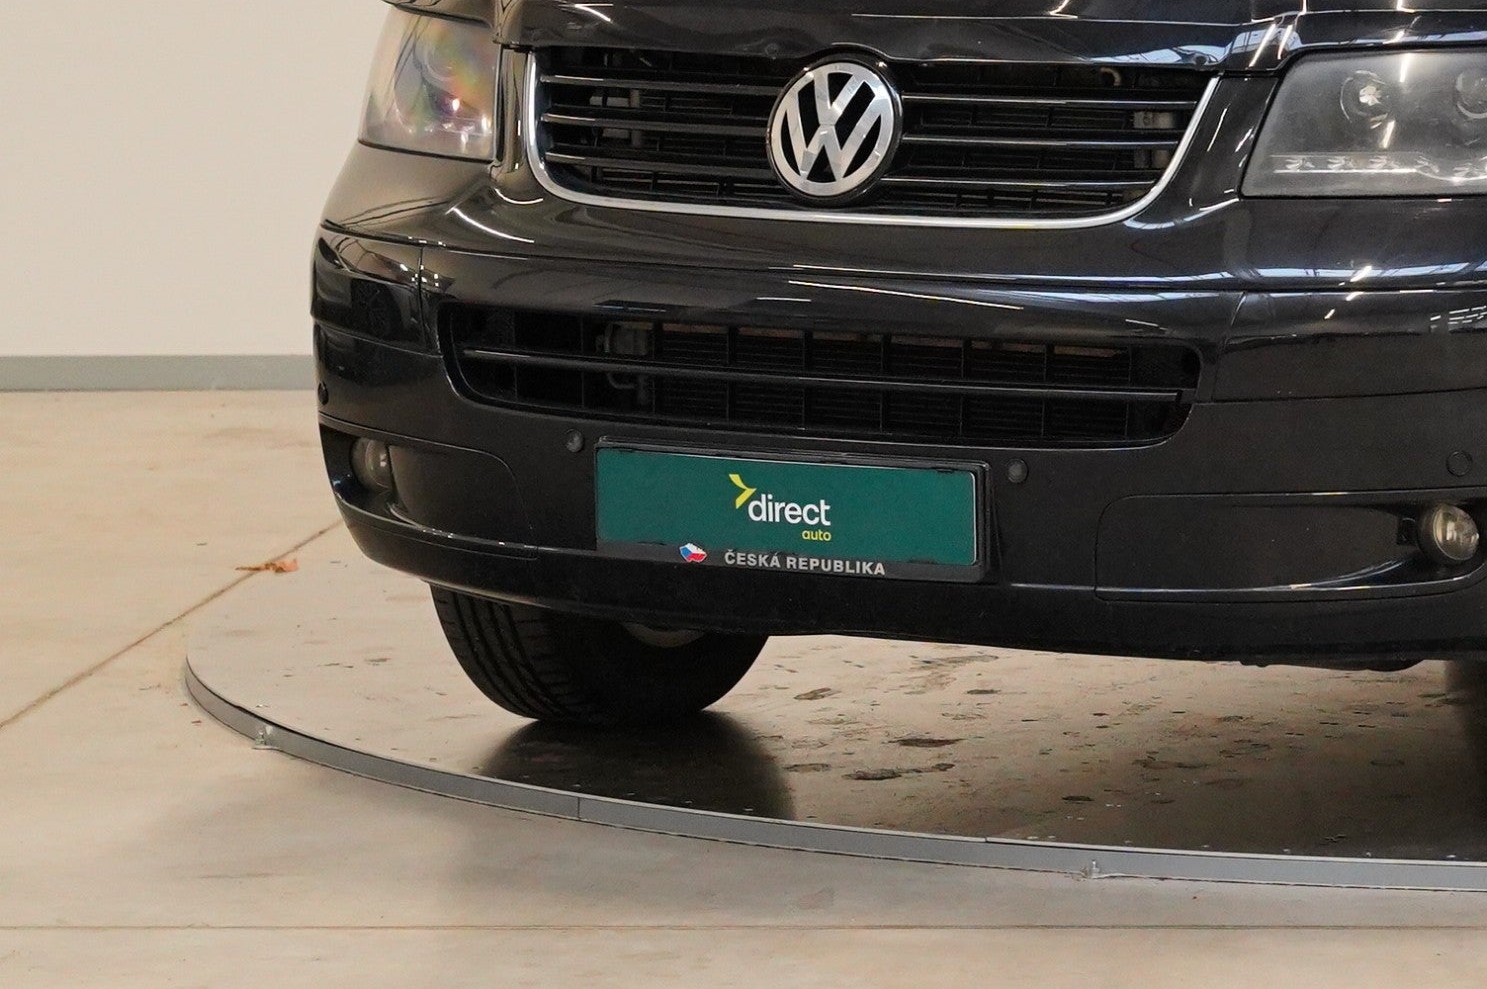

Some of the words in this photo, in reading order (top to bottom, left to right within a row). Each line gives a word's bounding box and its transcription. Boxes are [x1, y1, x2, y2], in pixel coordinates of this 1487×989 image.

[771, 62, 894, 197] VW
[748, 494, 831, 526] direct
[802, 529, 831, 541] auto
[724, 548, 781, 568] ČESKÁ
[786, 556, 886, 575] REPUBLIKA
